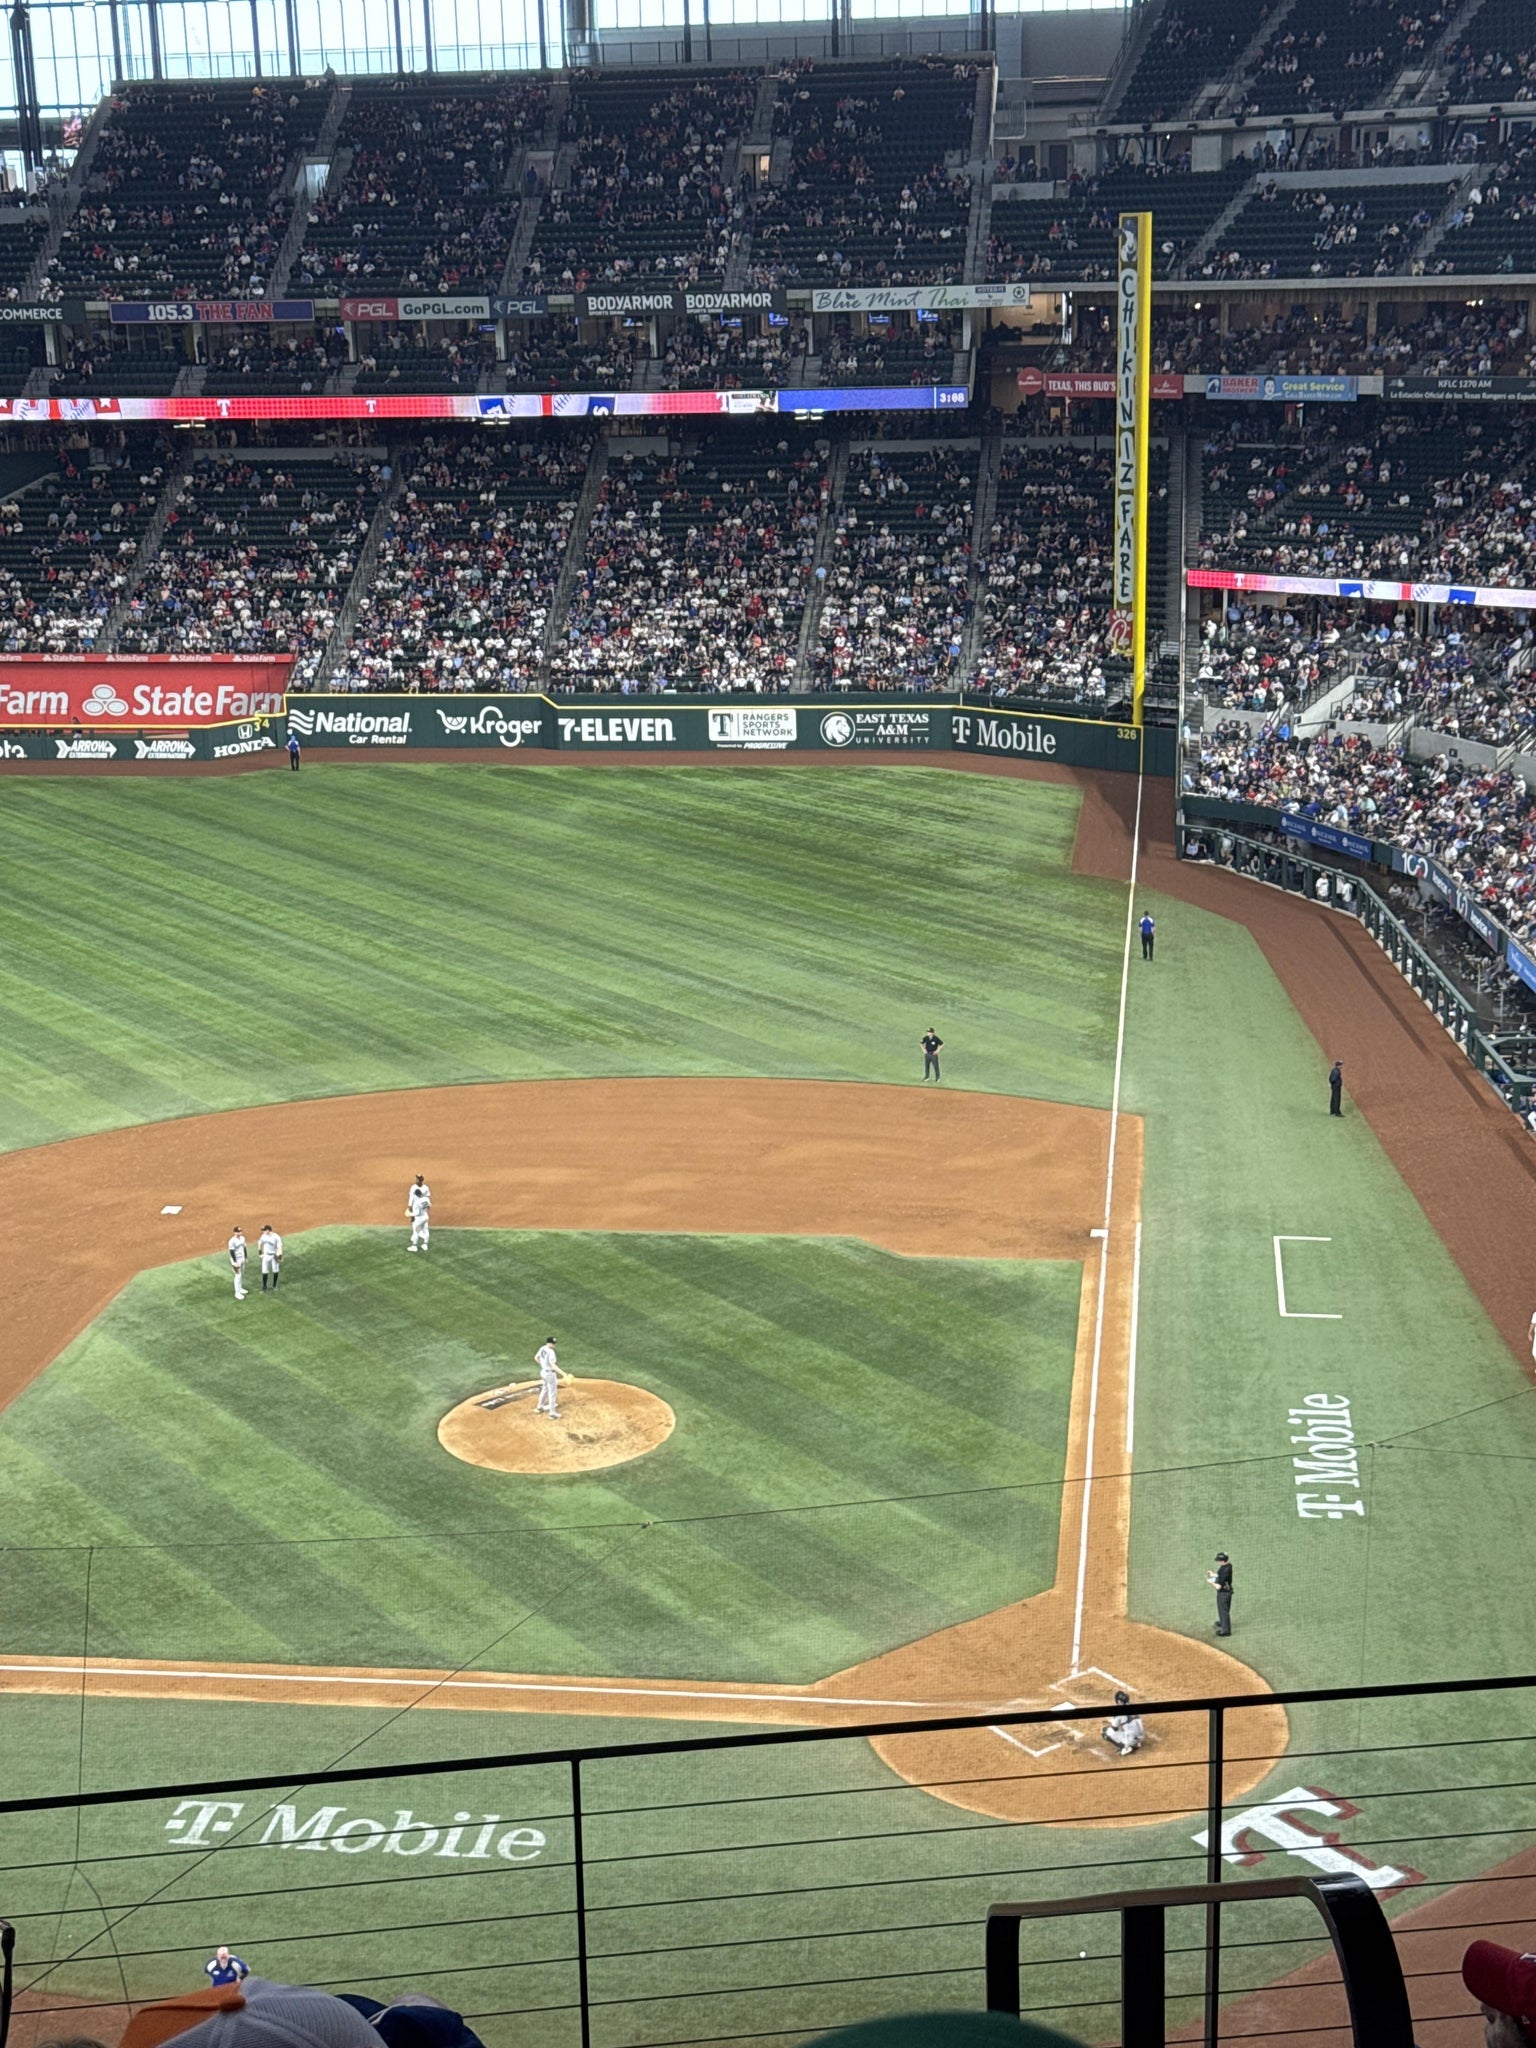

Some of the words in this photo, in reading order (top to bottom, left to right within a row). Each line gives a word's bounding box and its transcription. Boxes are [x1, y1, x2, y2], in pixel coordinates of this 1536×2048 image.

[587, 295, 673, 310] BODYARMOR
[685, 293, 772, 308] BODYARMOR
[816, 292, 862, 310] Blue
[864, 290, 922, 307] Mint
[927, 288, 969, 306] Thai
[148, 305, 194, 320] 105.3
[195, 304, 233, 319] THE
[236, 303, 274, 318] FAN
[357, 303, 394, 317] PGL
[403, 303, 485, 315] GoPGL.com
[503, 301, 544, 314] PGL
[1048, 380, 1073, 391] TEXAS,
[1075, 381, 1092, 391] THIS
[1093, 382, 1116, 391] BUD'S
[1222, 377, 1258, 387] BAKER
[1282, 382, 1307, 391] Great
[1310, 381, 1345, 392] Service
[1438, 379, 1457, 388] KFLC
[1459, 379, 1477, 388] 1270
[1477, 379, 1492, 388] AM
[939, 393, 965, 403] 3:08
[315, 712, 410, 733] National
[856, 714, 885, 723] EAST
[890, 714, 929, 723] TEXAS
[470, 706, 543, 747] Kroger
[876, 725, 909, 736] A&M
[349, 734, 368, 744] Car
[371, 734, 407, 744] Rental
[977, 719, 1056, 754] Mobile
[1117, 728, 1137, 739] 326
[71, 740, 106, 751] ARROW
[151, 740, 186, 751] ARROW
[855, 736, 930, 744] UNIVERSITY
[257, 1804, 547, 1862] Mobile
